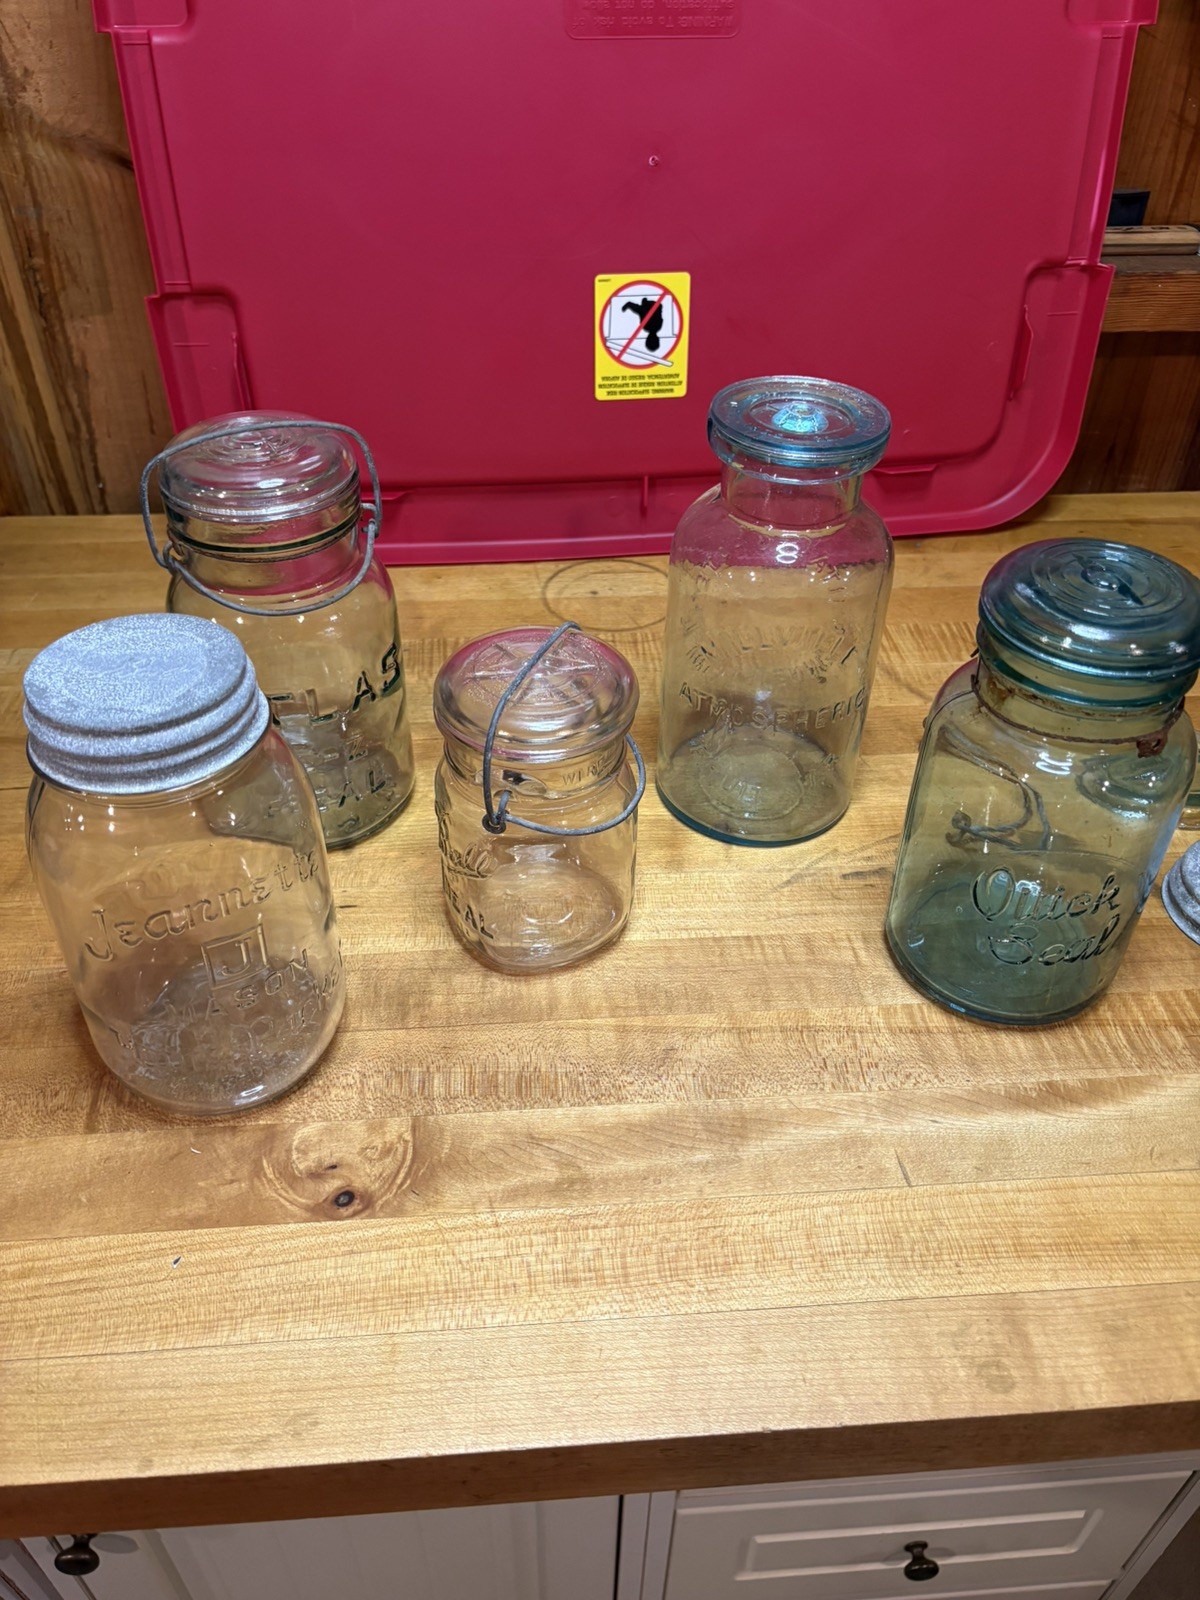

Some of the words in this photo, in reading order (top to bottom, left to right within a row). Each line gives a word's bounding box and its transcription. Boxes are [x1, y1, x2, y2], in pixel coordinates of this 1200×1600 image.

[615, 0, 636, 10] not
[640, 0, 654, 10] do
[571, 17, 585, 30] of
[592, 16, 615, 29] risk
[622, 16, 655, 28] avoid
[658, 16, 676, 28] To
[678, 681, 866, 737] ATMOSPHERIC
[971, 866, 1122, 922] Quick
